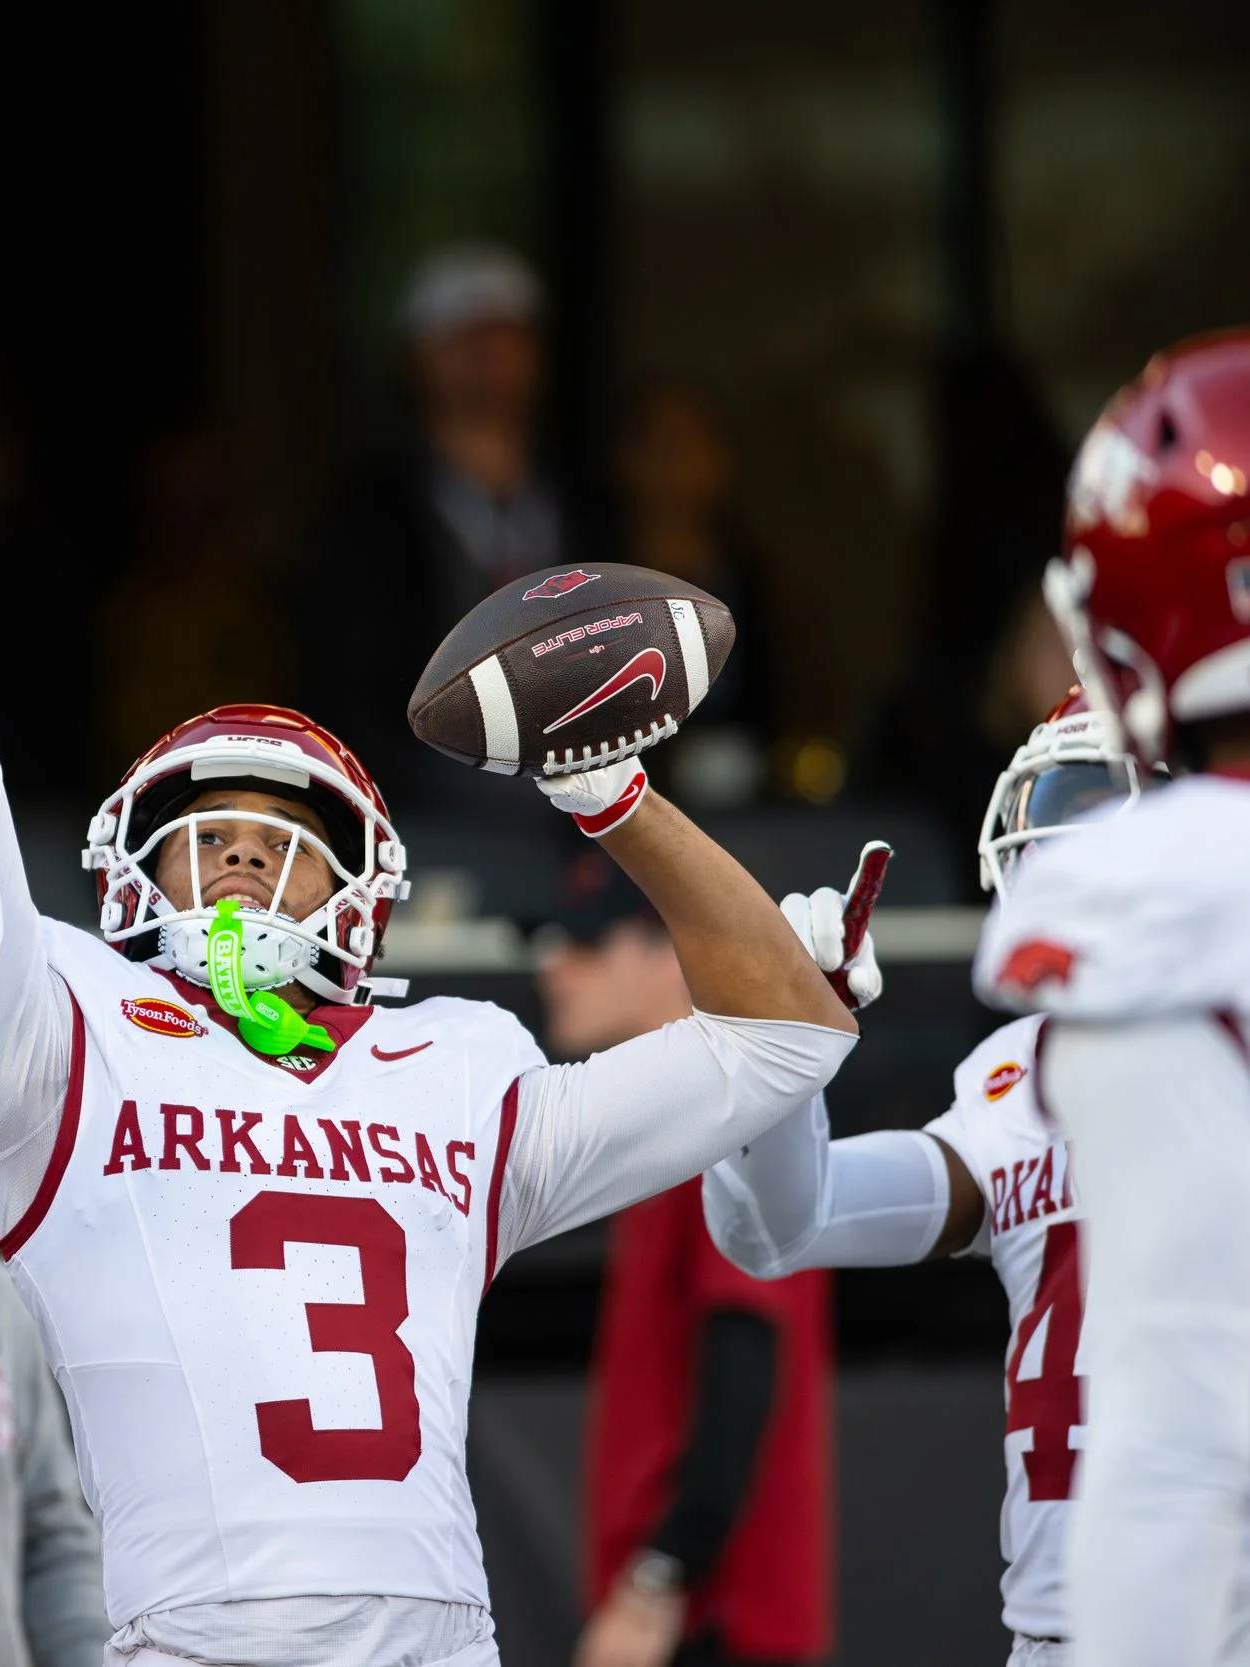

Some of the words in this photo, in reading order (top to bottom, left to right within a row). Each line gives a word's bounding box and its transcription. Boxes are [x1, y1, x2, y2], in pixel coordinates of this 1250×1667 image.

[531, 627, 586, 658] ELITE
[586, 612, 643, 635] VAPOR
[276, 1055, 317, 1071] SEC
[103, 1099, 476, 1218] ARKANSAS
[229, 1190, 423, 1484] 3
[1005, 1220, 1090, 1502] 4
